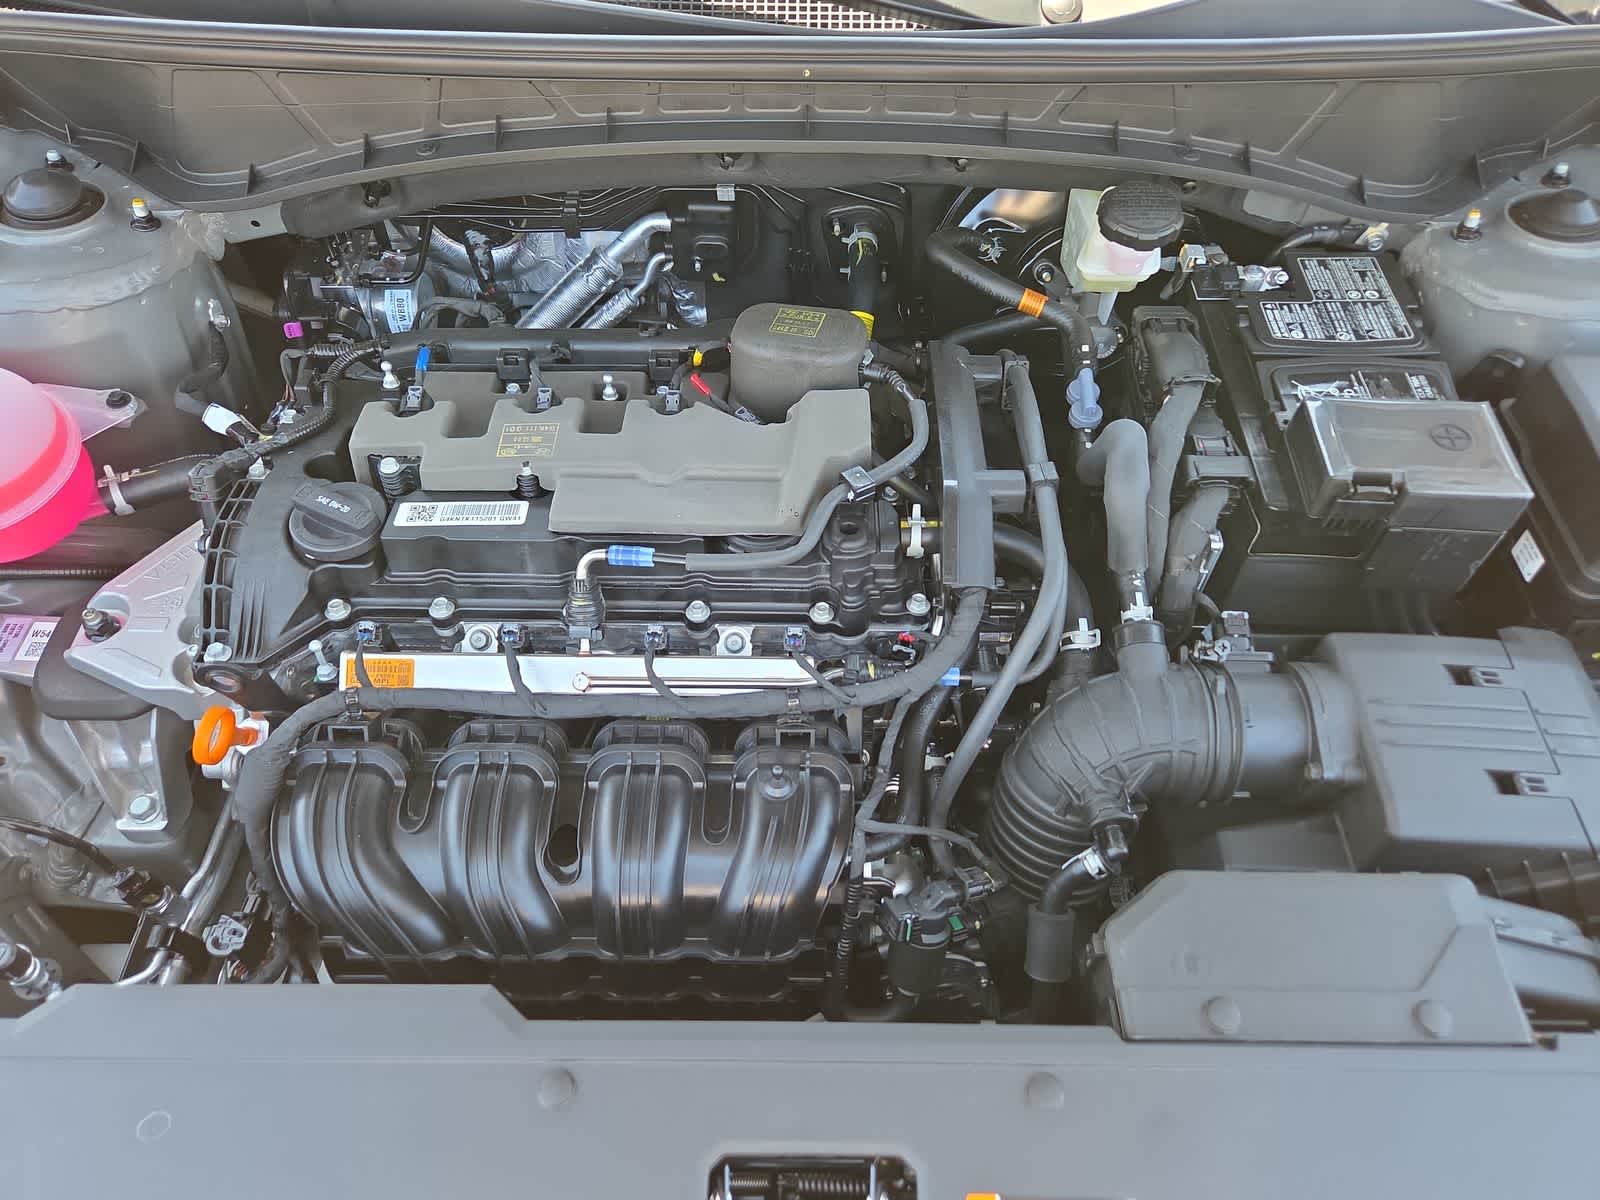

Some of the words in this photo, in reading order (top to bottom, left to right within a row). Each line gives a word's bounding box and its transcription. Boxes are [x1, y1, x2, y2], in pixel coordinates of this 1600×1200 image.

[315, 495, 331, 505] SAE
[328, 500, 352, 513] 0W-20
[32, 629, 52, 638] W54
